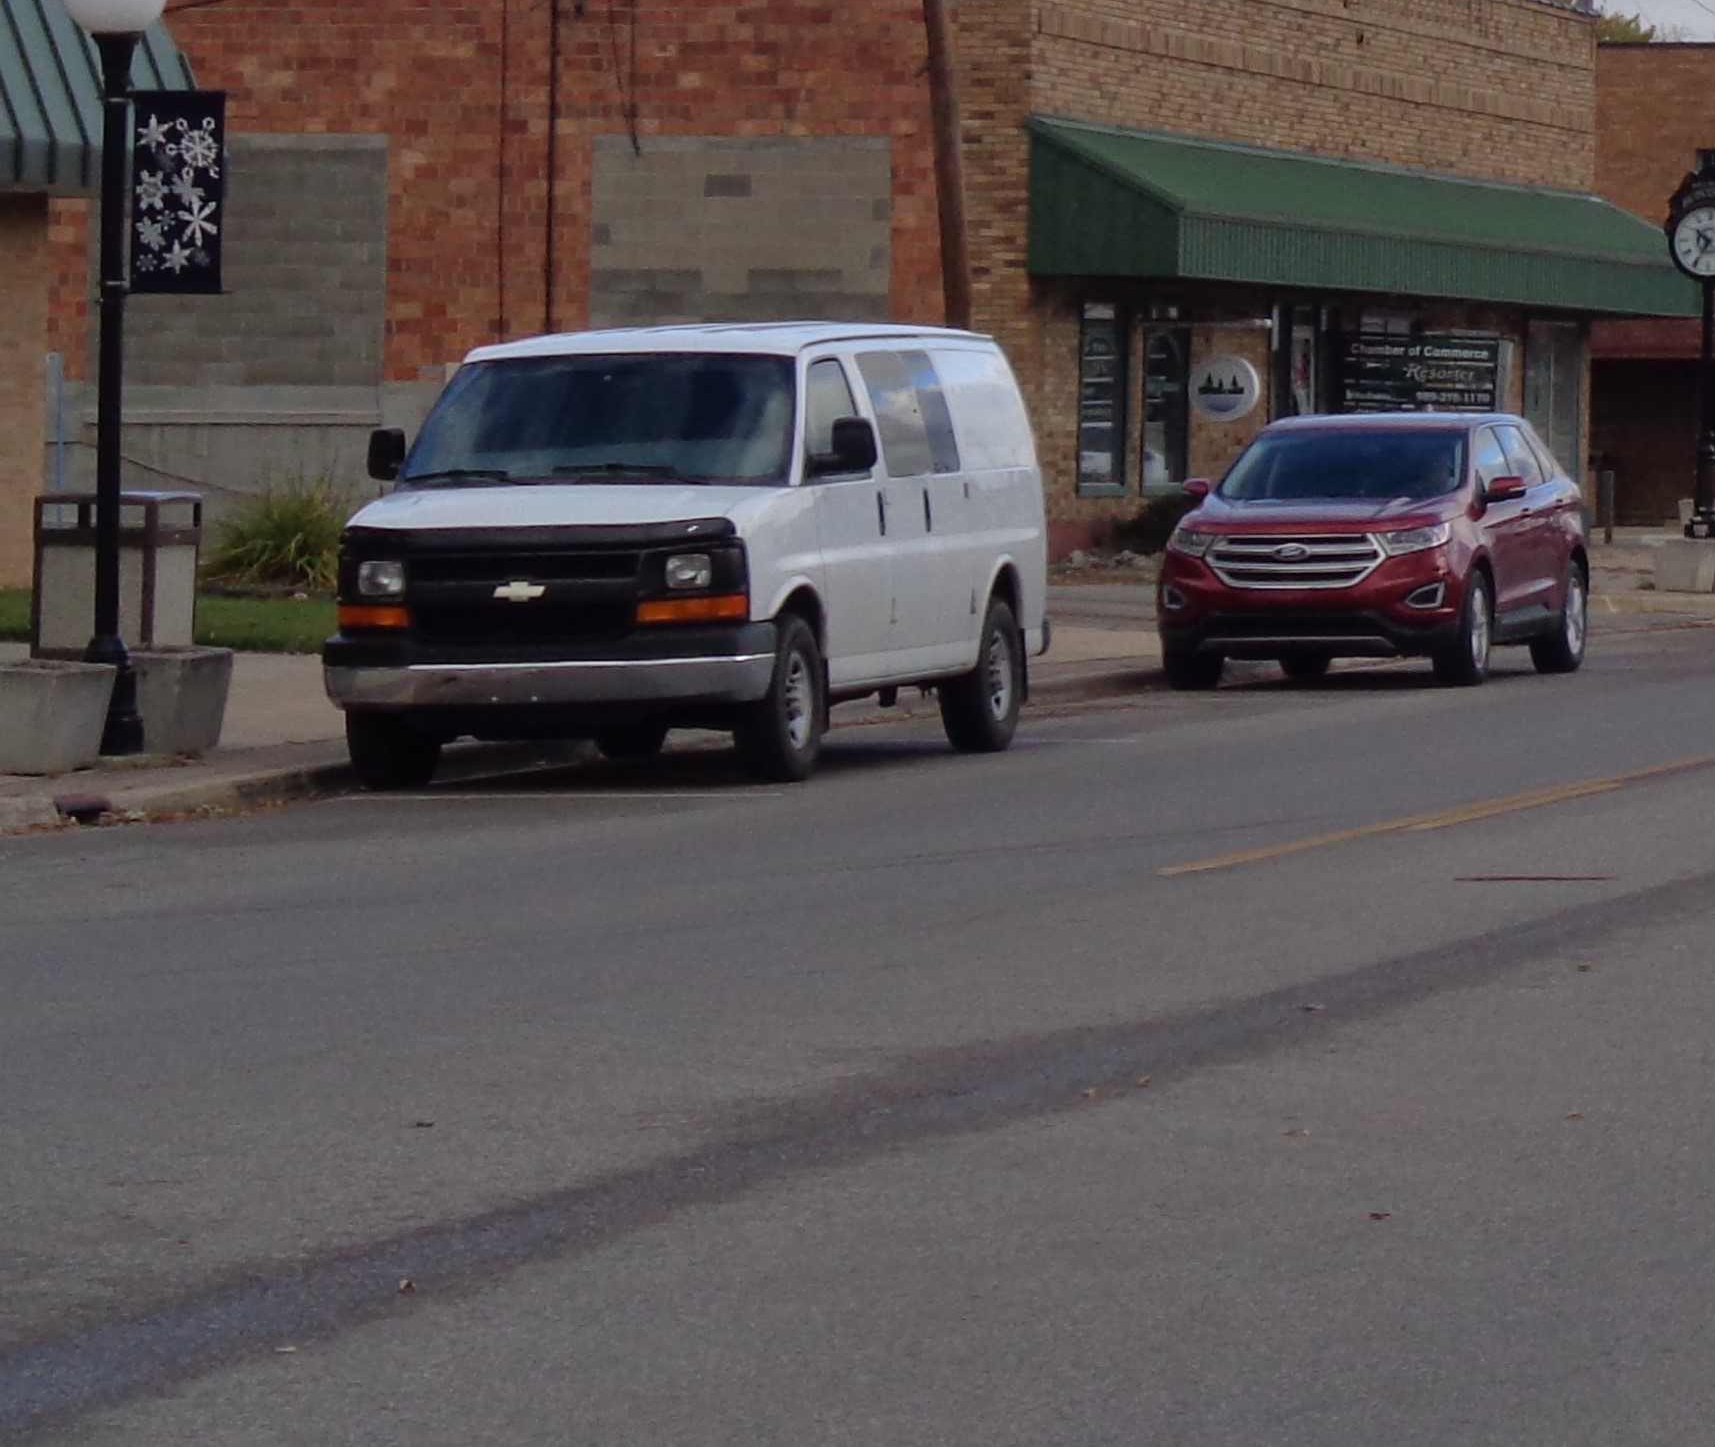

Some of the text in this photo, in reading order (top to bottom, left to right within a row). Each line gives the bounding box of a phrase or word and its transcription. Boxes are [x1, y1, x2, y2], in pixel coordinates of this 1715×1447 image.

[1351, 343, 1489, 360] Chamber of Commerce
